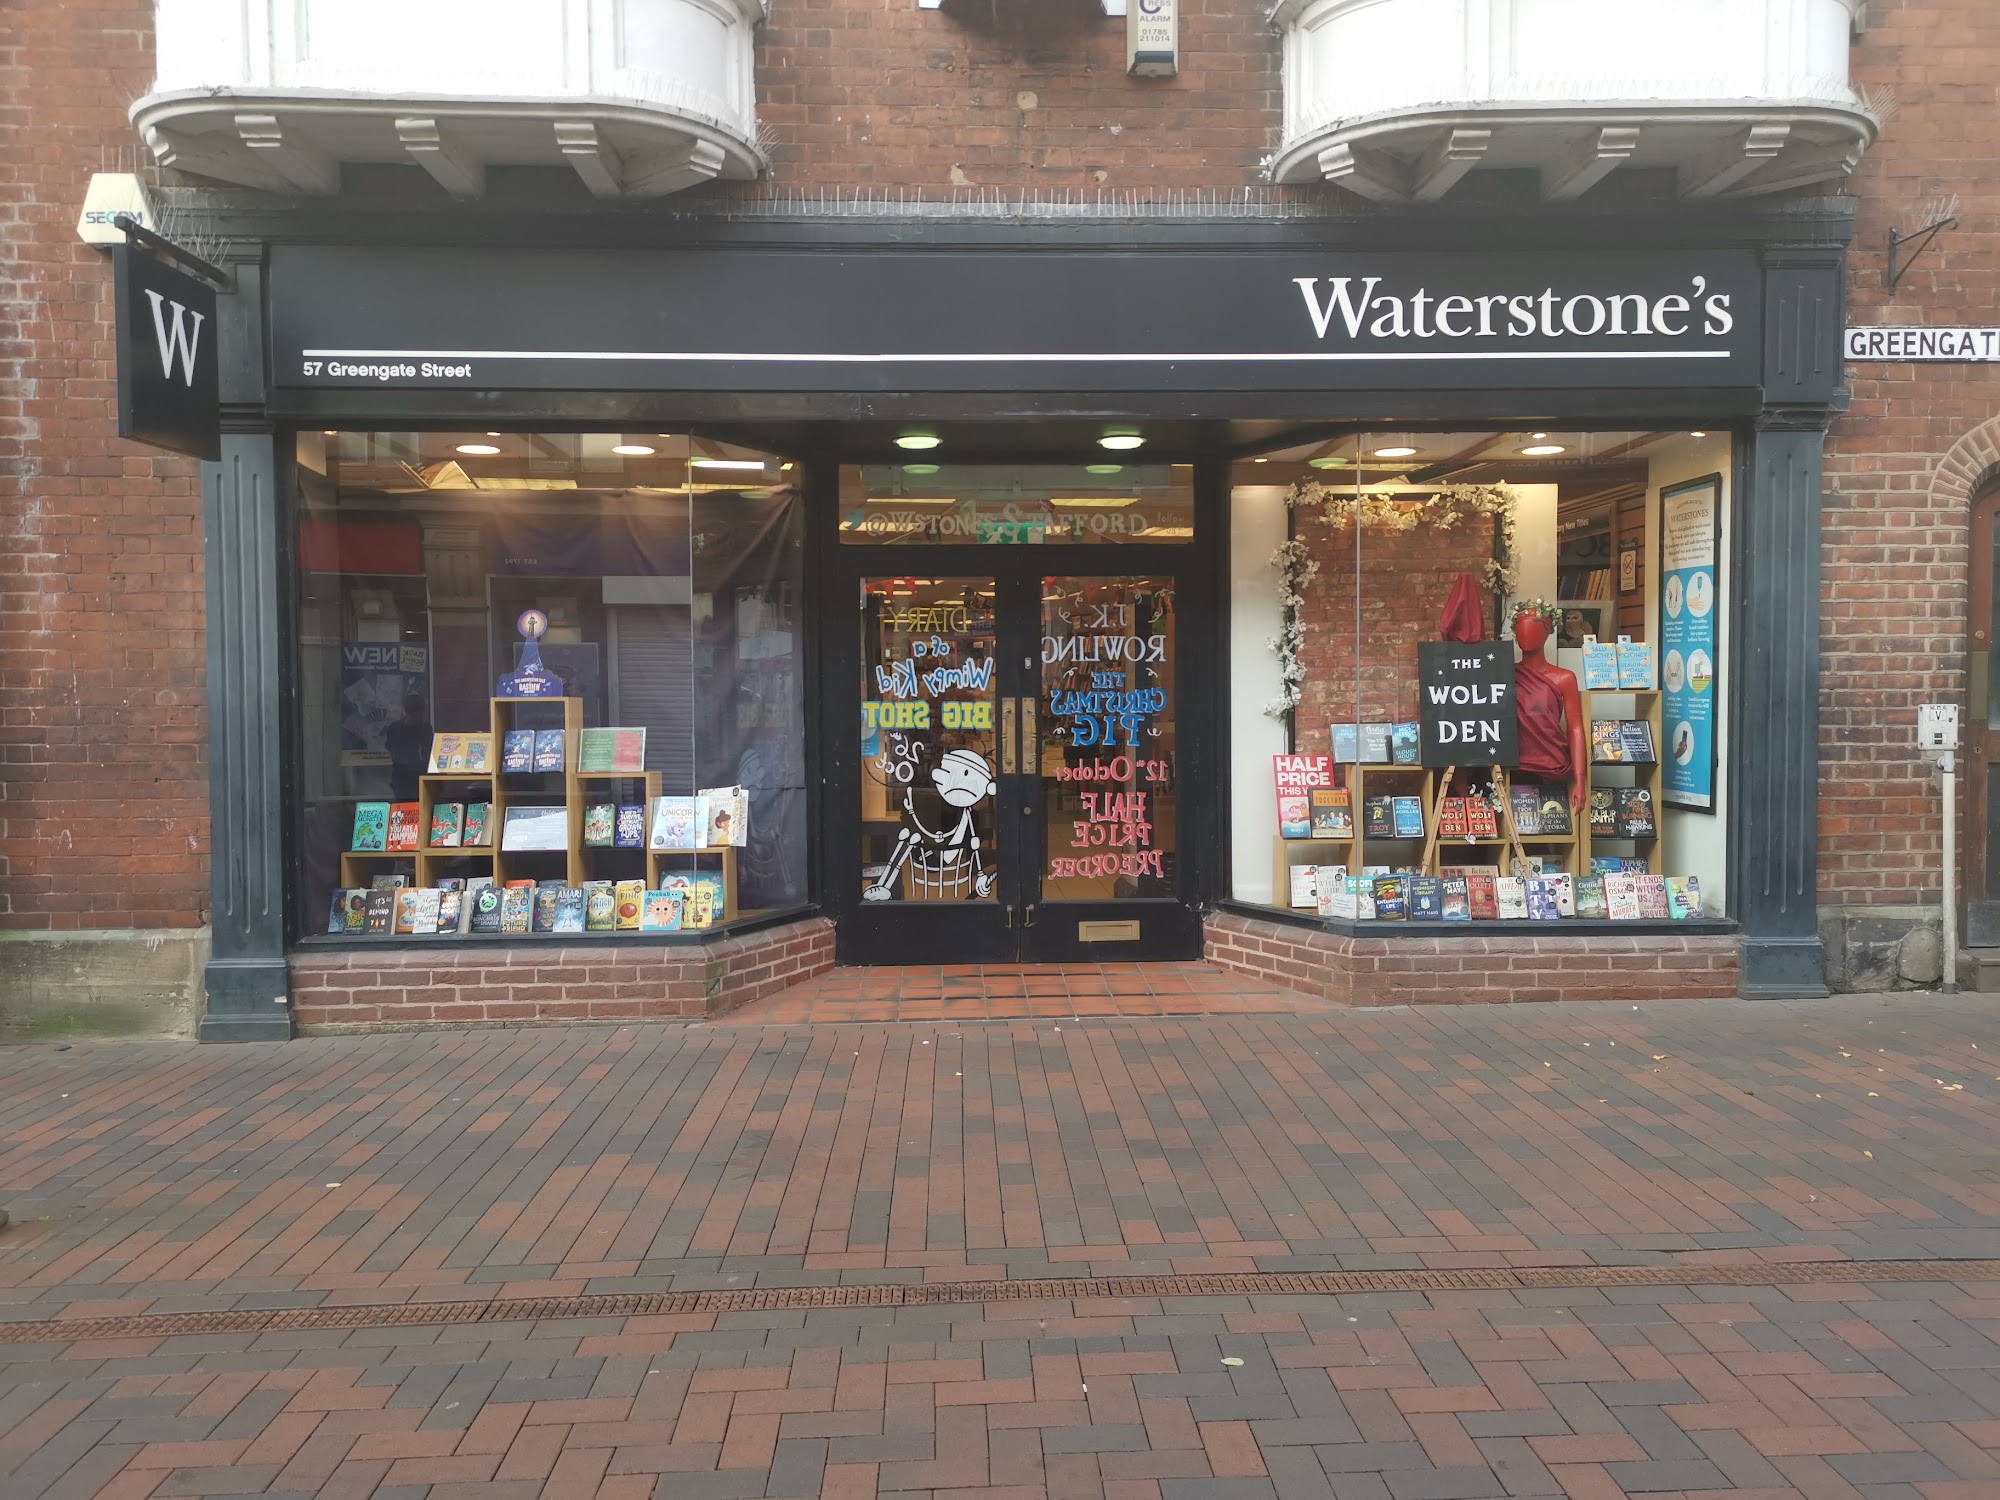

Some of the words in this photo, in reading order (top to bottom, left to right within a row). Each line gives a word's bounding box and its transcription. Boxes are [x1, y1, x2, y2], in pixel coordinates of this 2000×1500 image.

[1292, 275, 1734, 339] Waterstone's
[144, 288, 205, 387] W
[1850, 331, 2000, 356] GREENGAT
[303, 362, 323, 376] 57
[327, 361, 417, 381] Greengate
[420, 362, 472, 378] Street
[1451, 659, 1482, 670] THE
[1428, 683, 1507, 705] WOLF
[1437, 719, 1502, 744] DEN
[1275, 756, 1329, 772] HALF
[1277, 771, 1331, 786] PRICE
[1278, 786, 1301, 795] THIS
[1315, 796, 1346, 804] TOGETHER
[661, 808, 700, 817] UNICORN
[1442, 881, 1465, 889] PETER
[1645, 876, 1664, 884] ENDS
[557, 889, 582, 898] AMARI
[1640, 909, 1669, 917] HOOVER
